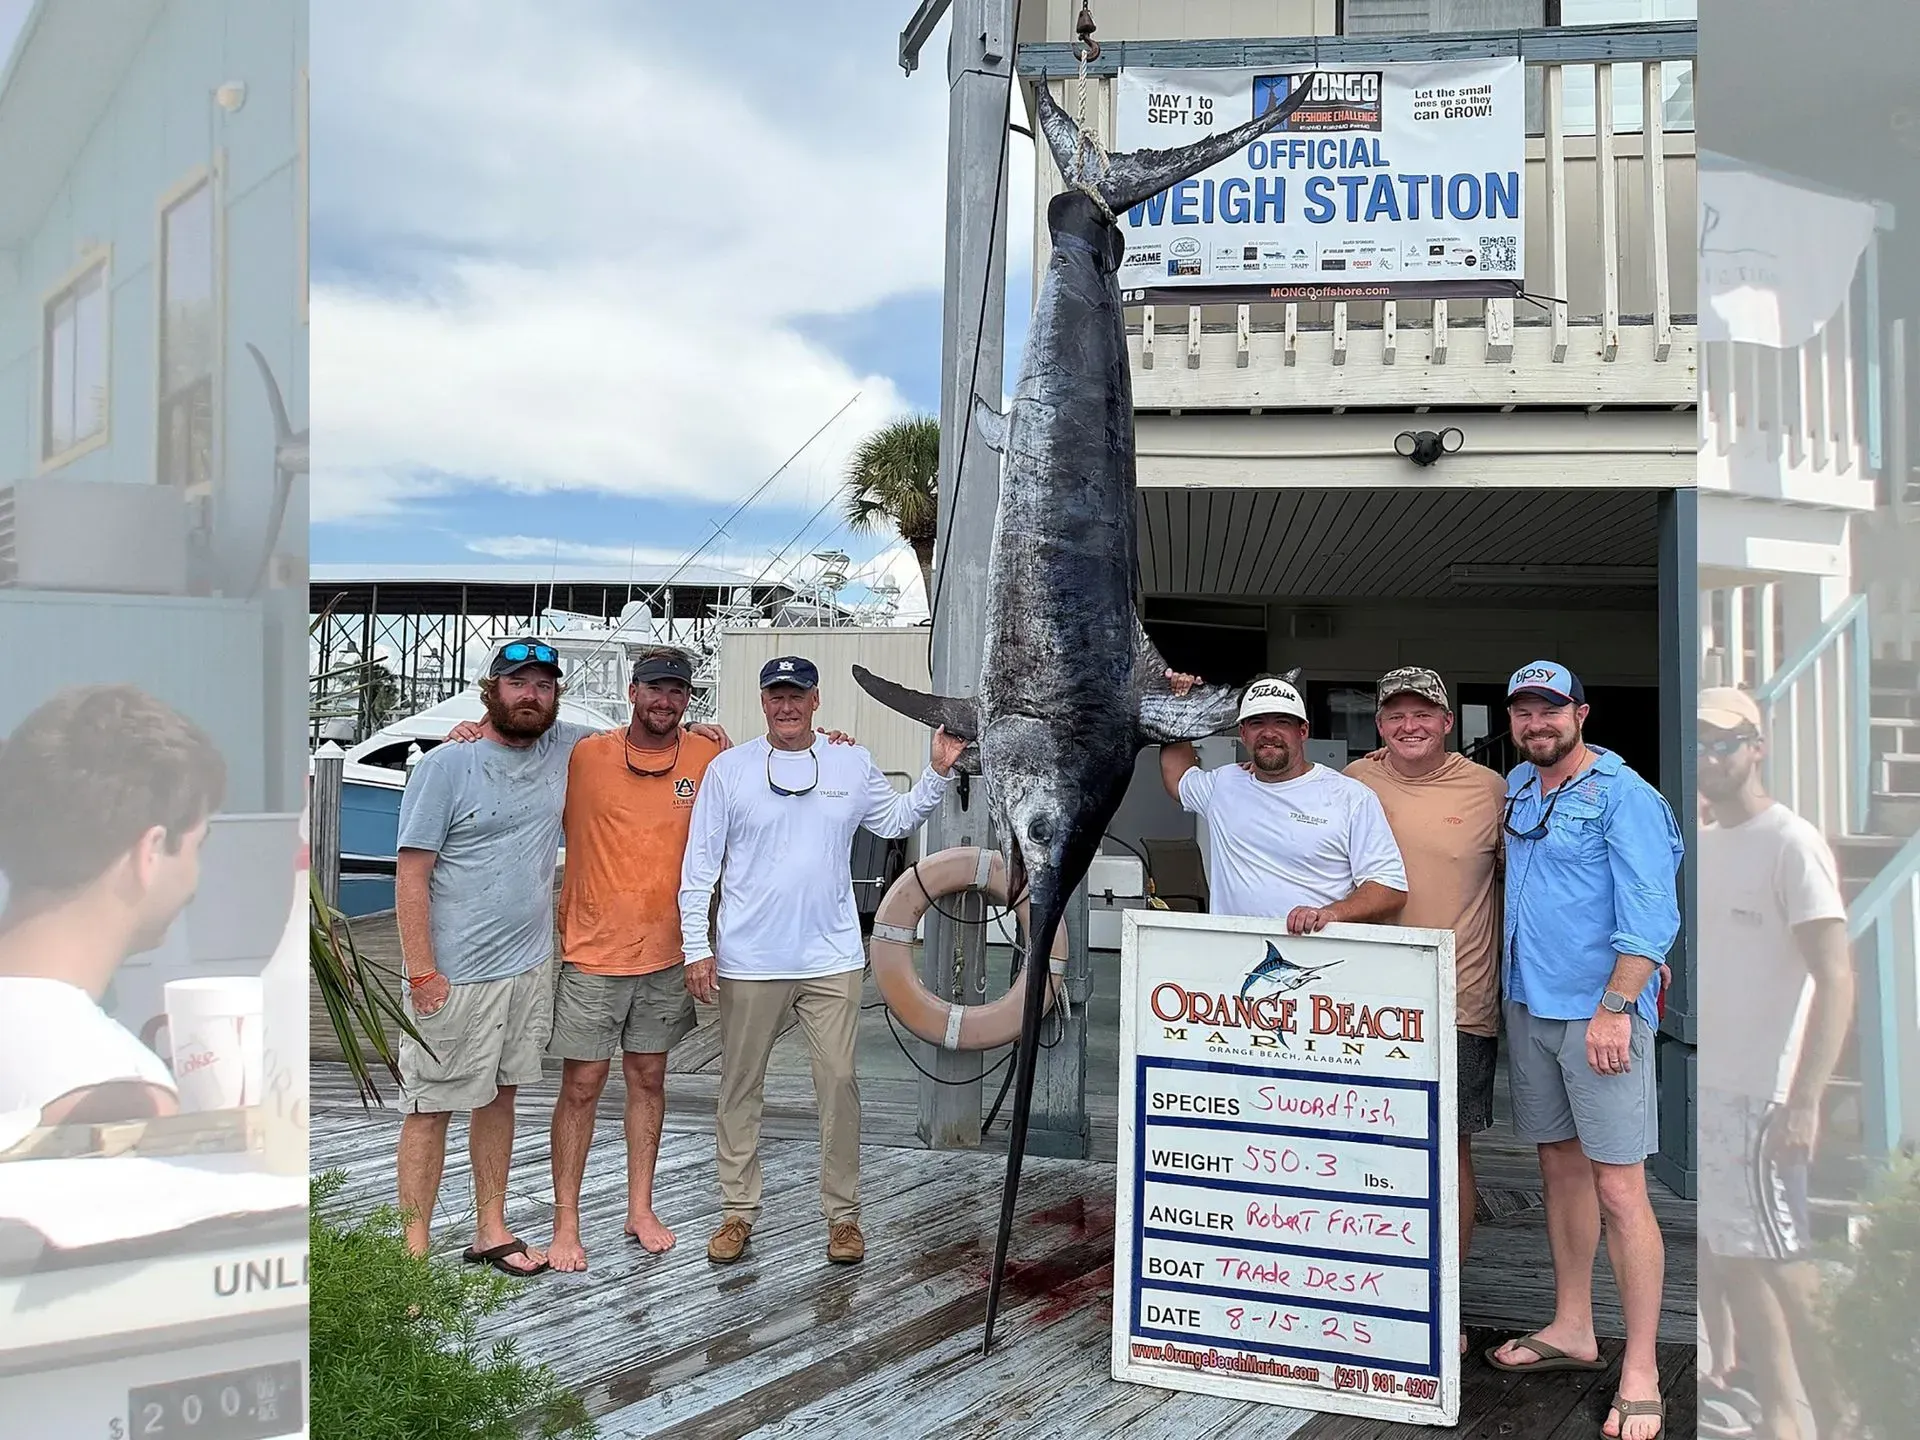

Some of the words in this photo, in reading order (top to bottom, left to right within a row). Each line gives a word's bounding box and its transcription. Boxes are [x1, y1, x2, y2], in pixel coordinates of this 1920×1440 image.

[1148, 93, 1181, 108] MAY
[1185, 95, 1193, 109] 1
[1198, 95, 1214, 110] to
[1414, 100, 1438, 108] ones
[1440, 99, 1453, 108] go
[1455, 98, 1467, 106] so
[1470, 96, 1492, 105] they
[1415, 90, 1433, 99] Let
[1437, 88, 1455, 98] the
[1459, 84, 1492, 96] small
[1147, 108, 1189, 125] SEPT
[1193, 110, 1214, 126] 30
[1291, 111, 1333, 122] OFFSHORE
[1333, 110, 1378, 122] CHALLENGE
[1413, 110, 1439, 121] can
[1444, 105, 1492, 119] GROW!
[1247, 137, 1391, 170] OFFICIAL
[1127, 176, 1286, 228] WEIGH
[1303, 171, 1519, 224] STATION
[1163, 1027, 1411, 1060] MARINA
[1208, 1045, 1255, 1057] ORANGE
[1259, 1050, 1302, 1062] BEACH,
[1305, 1054, 1362, 1066] ALABAMA
[1152, 1092, 1240, 1116] SPECIES
[1152, 1149, 1234, 1174] WEIGHT
[1242, 1145, 1338, 1177] 550.3
[1364, 1173, 1394, 1190] lbs.
[1149, 1206, 1234, 1231] ANGLER
[1149, 1257, 1205, 1279] BOAT
[1147, 1305, 1201, 1328] DATE
[1132, 1342, 1320, 1382] www.OrangeBeachMarina.com
[1333, 1366, 1369, 1393] (251)
[1372, 1372, 1439, 1399] 981-4207
